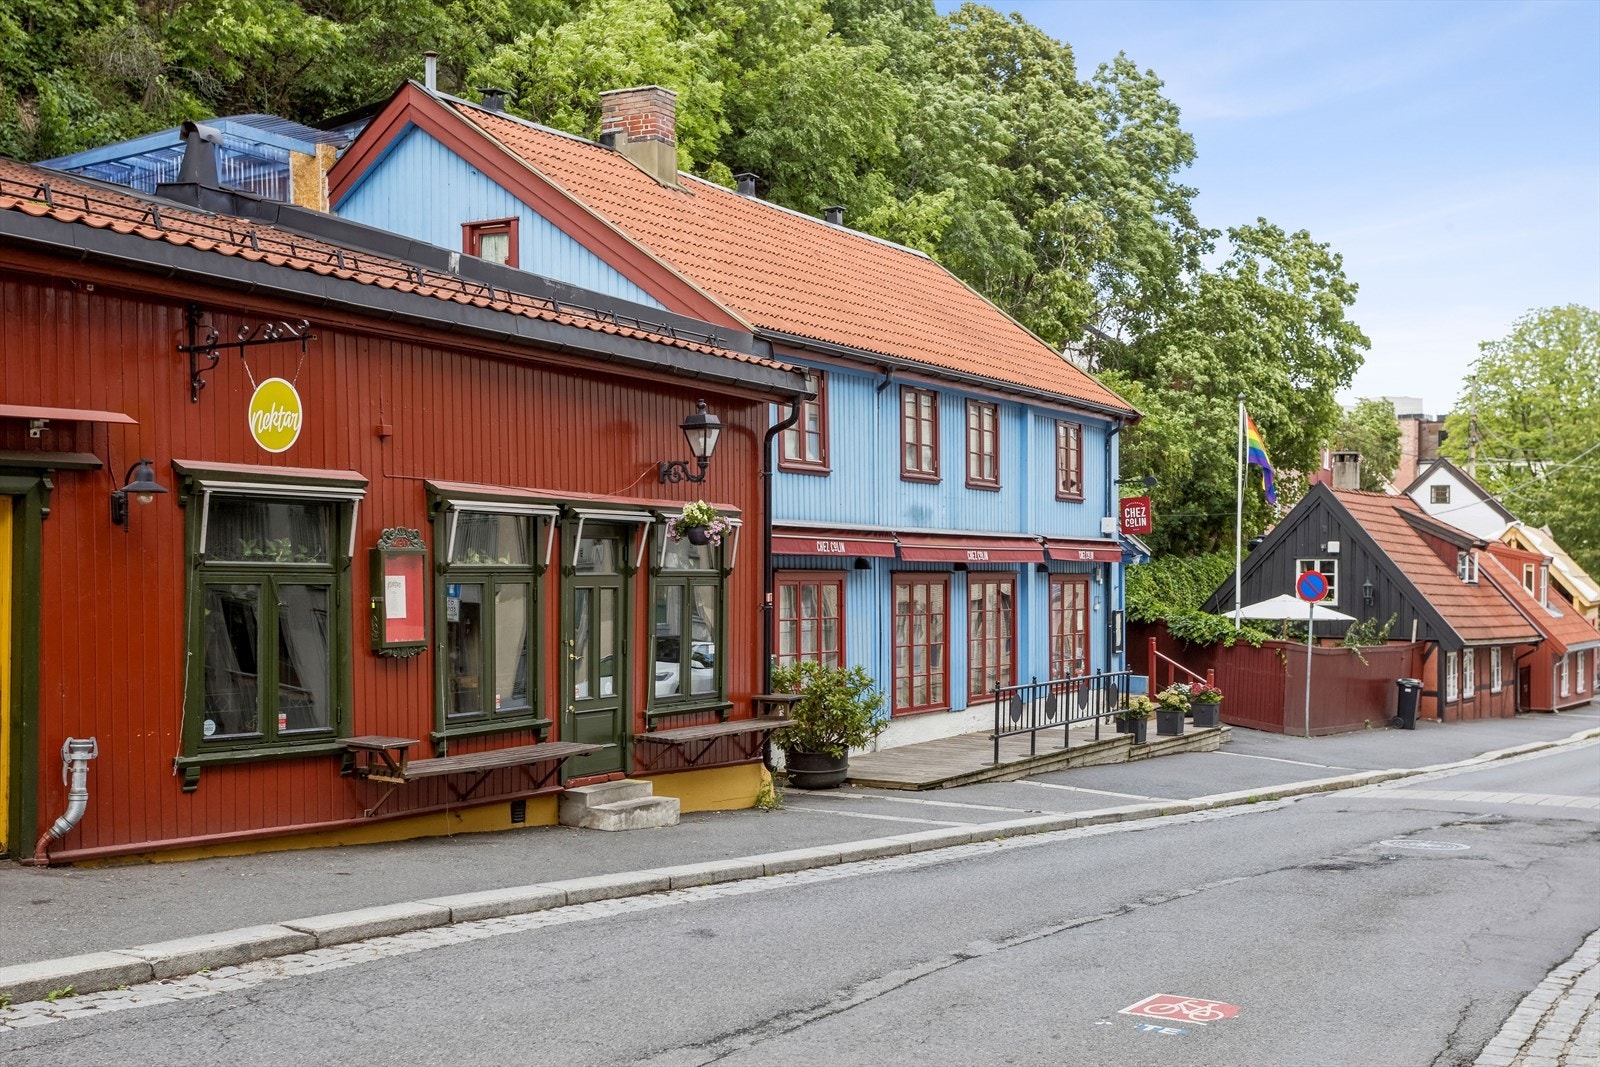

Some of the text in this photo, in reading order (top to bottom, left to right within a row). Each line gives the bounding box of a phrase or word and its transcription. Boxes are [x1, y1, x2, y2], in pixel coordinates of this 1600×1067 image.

[251, 402, 300, 434] nektar
[1125, 507, 1146, 518] CHEZ
[816, 540, 830, 553] CHEZ
